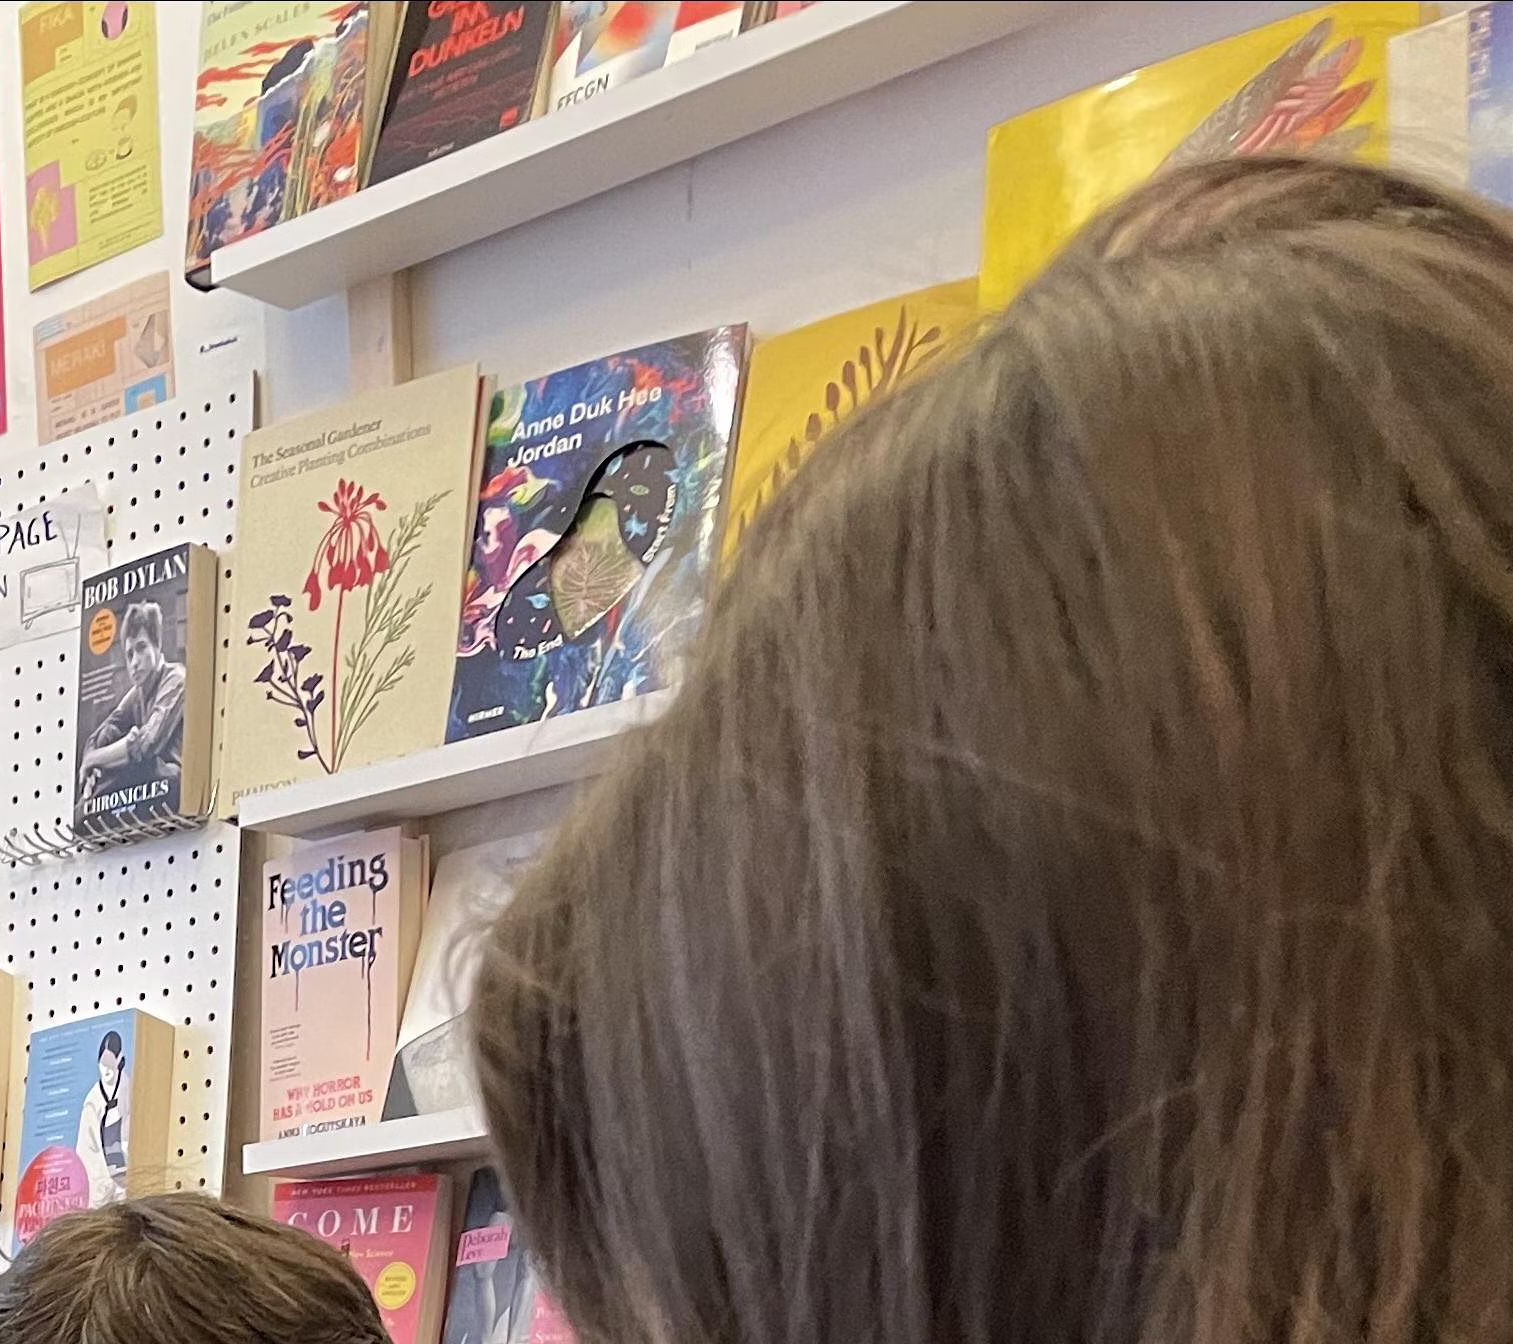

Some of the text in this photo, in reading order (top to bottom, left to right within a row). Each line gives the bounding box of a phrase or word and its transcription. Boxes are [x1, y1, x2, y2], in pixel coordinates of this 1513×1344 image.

[408, 6, 524, 77] DUNKELN
[510, 384, 664, 444] Anne Duk Hee
[249, 422, 433, 490] Creative Planting Combinations
[251, 417, 383, 470] The Seasonal Gardener
[507, 431, 583, 468] Jordan
[84, 552, 187, 610] BOB DYLAN
[83, 779, 169, 815] CHRONICLES
[268, 852, 389, 912] Feeding
[299, 899, 346, 937] the
[270, 926, 383, 979] Monster
[312, 1075, 361, 1097] HORROR
[357, 1089, 373, 1107] US
[287, 1204, 415, 1239] COME
